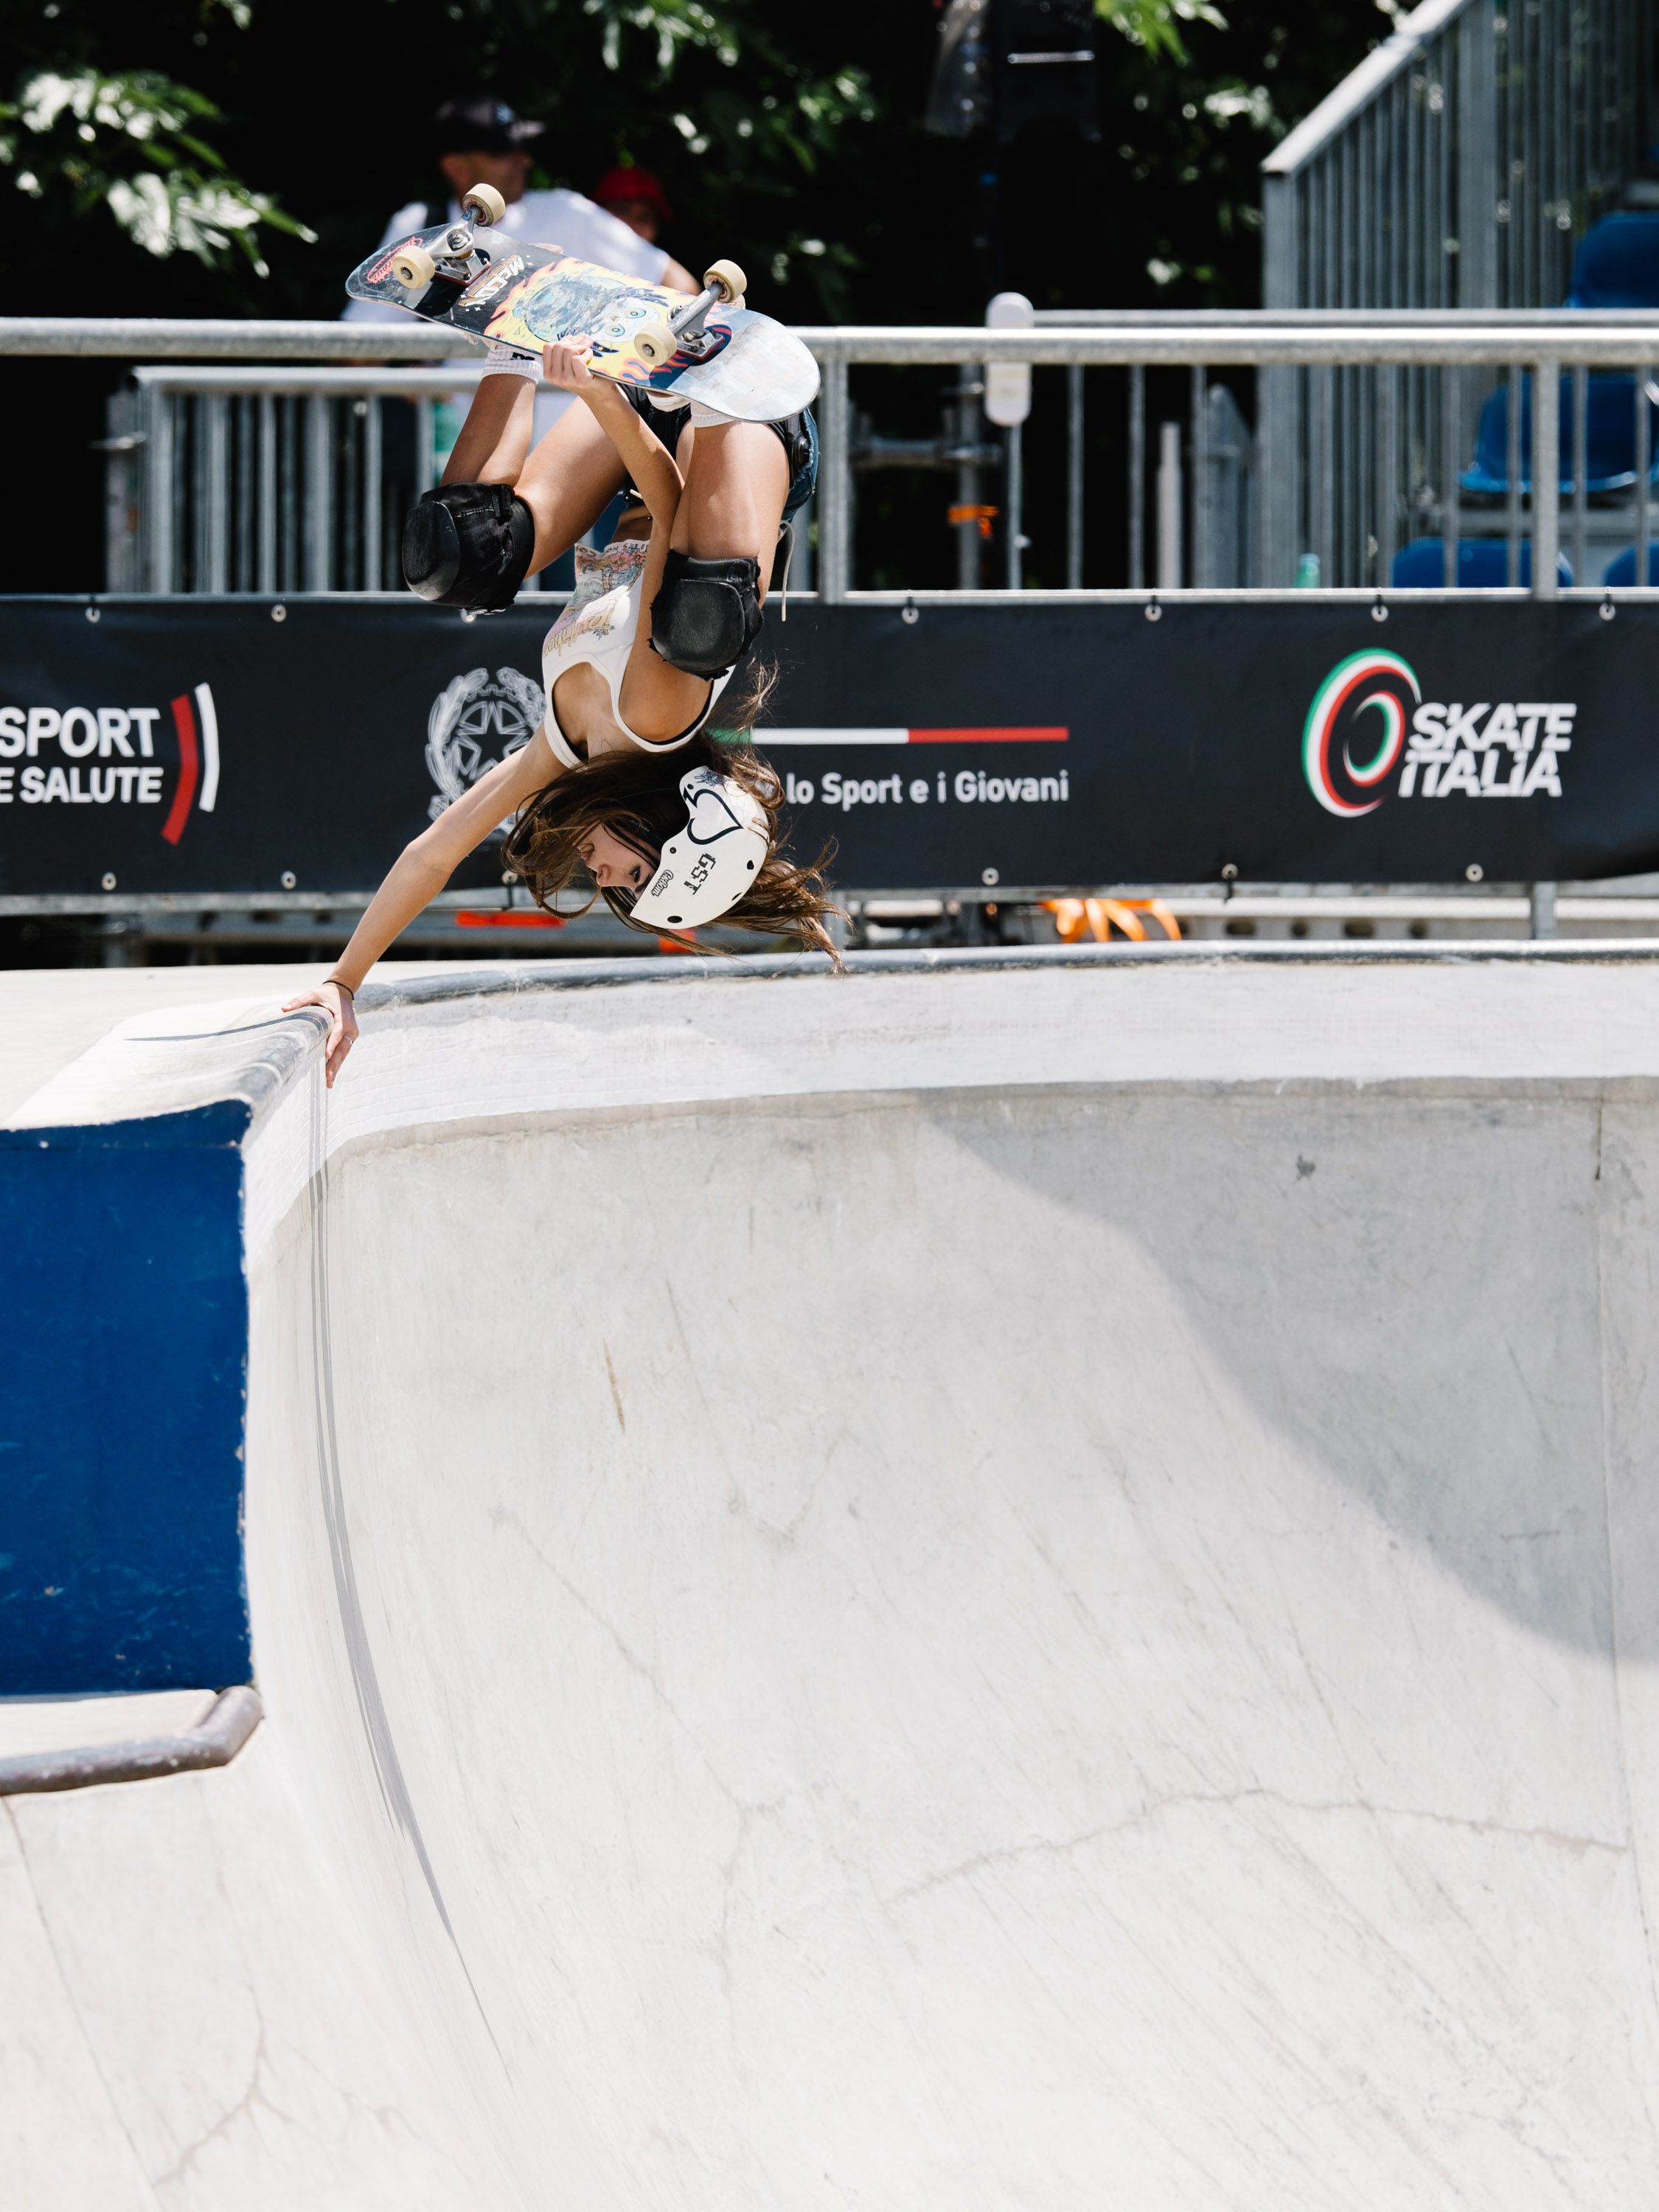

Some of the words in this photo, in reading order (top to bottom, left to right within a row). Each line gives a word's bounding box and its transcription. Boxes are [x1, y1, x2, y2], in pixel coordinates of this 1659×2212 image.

[0, 706, 161, 758] SPORT
[1408, 703, 1577, 751] SKATE
[20, 766, 164, 804] SALUTE
[786, 773, 814, 804] lo
[821, 772, 903, 812] Sport
[909, 779, 929, 804] e
[937, 771, 947, 803] i
[954, 769, 1068, 803] Giovani
[1398, 749, 1562, 797] ITALIA
[684, 852, 716, 895] GST
